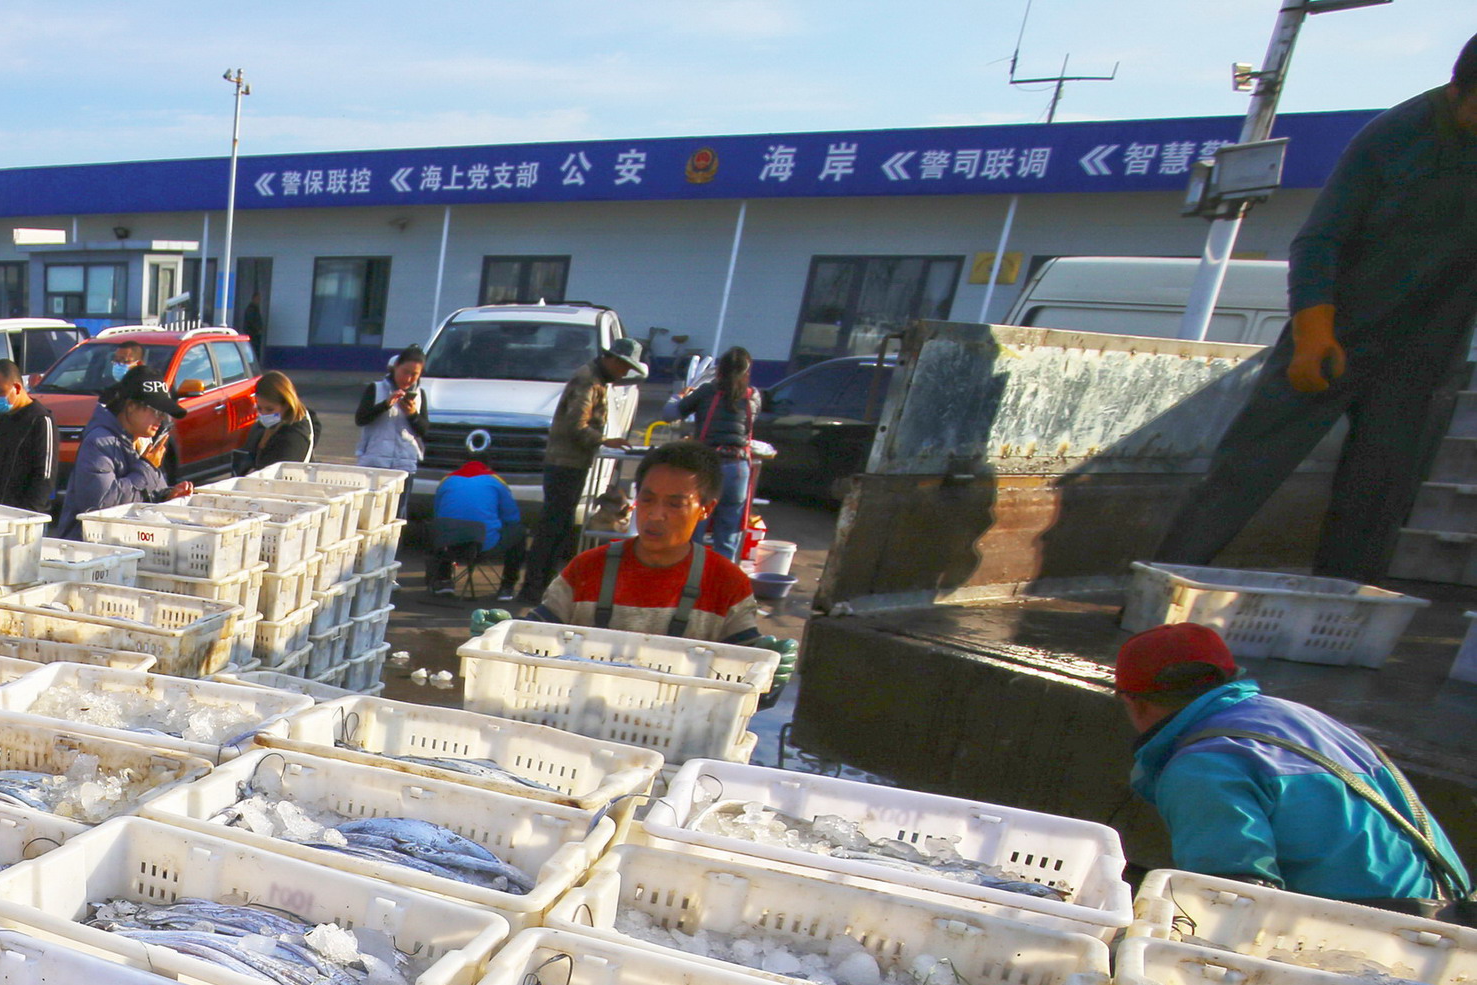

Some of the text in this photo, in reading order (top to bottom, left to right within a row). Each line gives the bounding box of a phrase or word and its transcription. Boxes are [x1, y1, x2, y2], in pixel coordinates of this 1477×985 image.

[281, 168, 371, 196] 警保联控
[420, 161, 540, 191] 海上党支部
[560, 150, 646, 186] 公安
[759, 142, 858, 182] 海岸
[919, 147, 1052, 180] 警司联调
[137, 531, 155, 542] 1001
